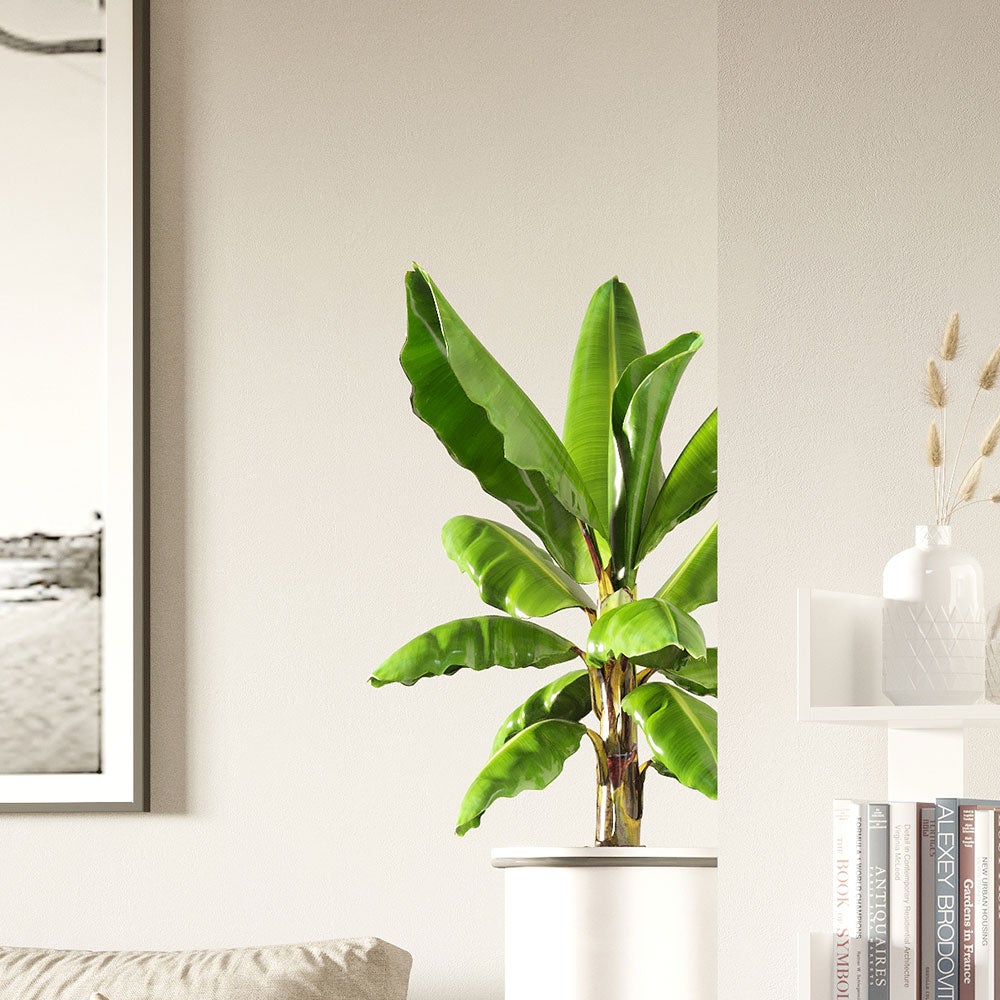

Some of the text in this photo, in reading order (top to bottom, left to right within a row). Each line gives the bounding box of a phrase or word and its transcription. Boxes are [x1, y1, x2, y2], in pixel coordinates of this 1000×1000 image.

[836, 858, 850, 907] BOOK
[938, 804, 955, 888] ALEXEY
[873, 865, 887, 987] ANTIQUAIRES
[963, 878, 974, 984] Gardens in France
[981, 856, 989, 946] NEW URBAN HOUSING
